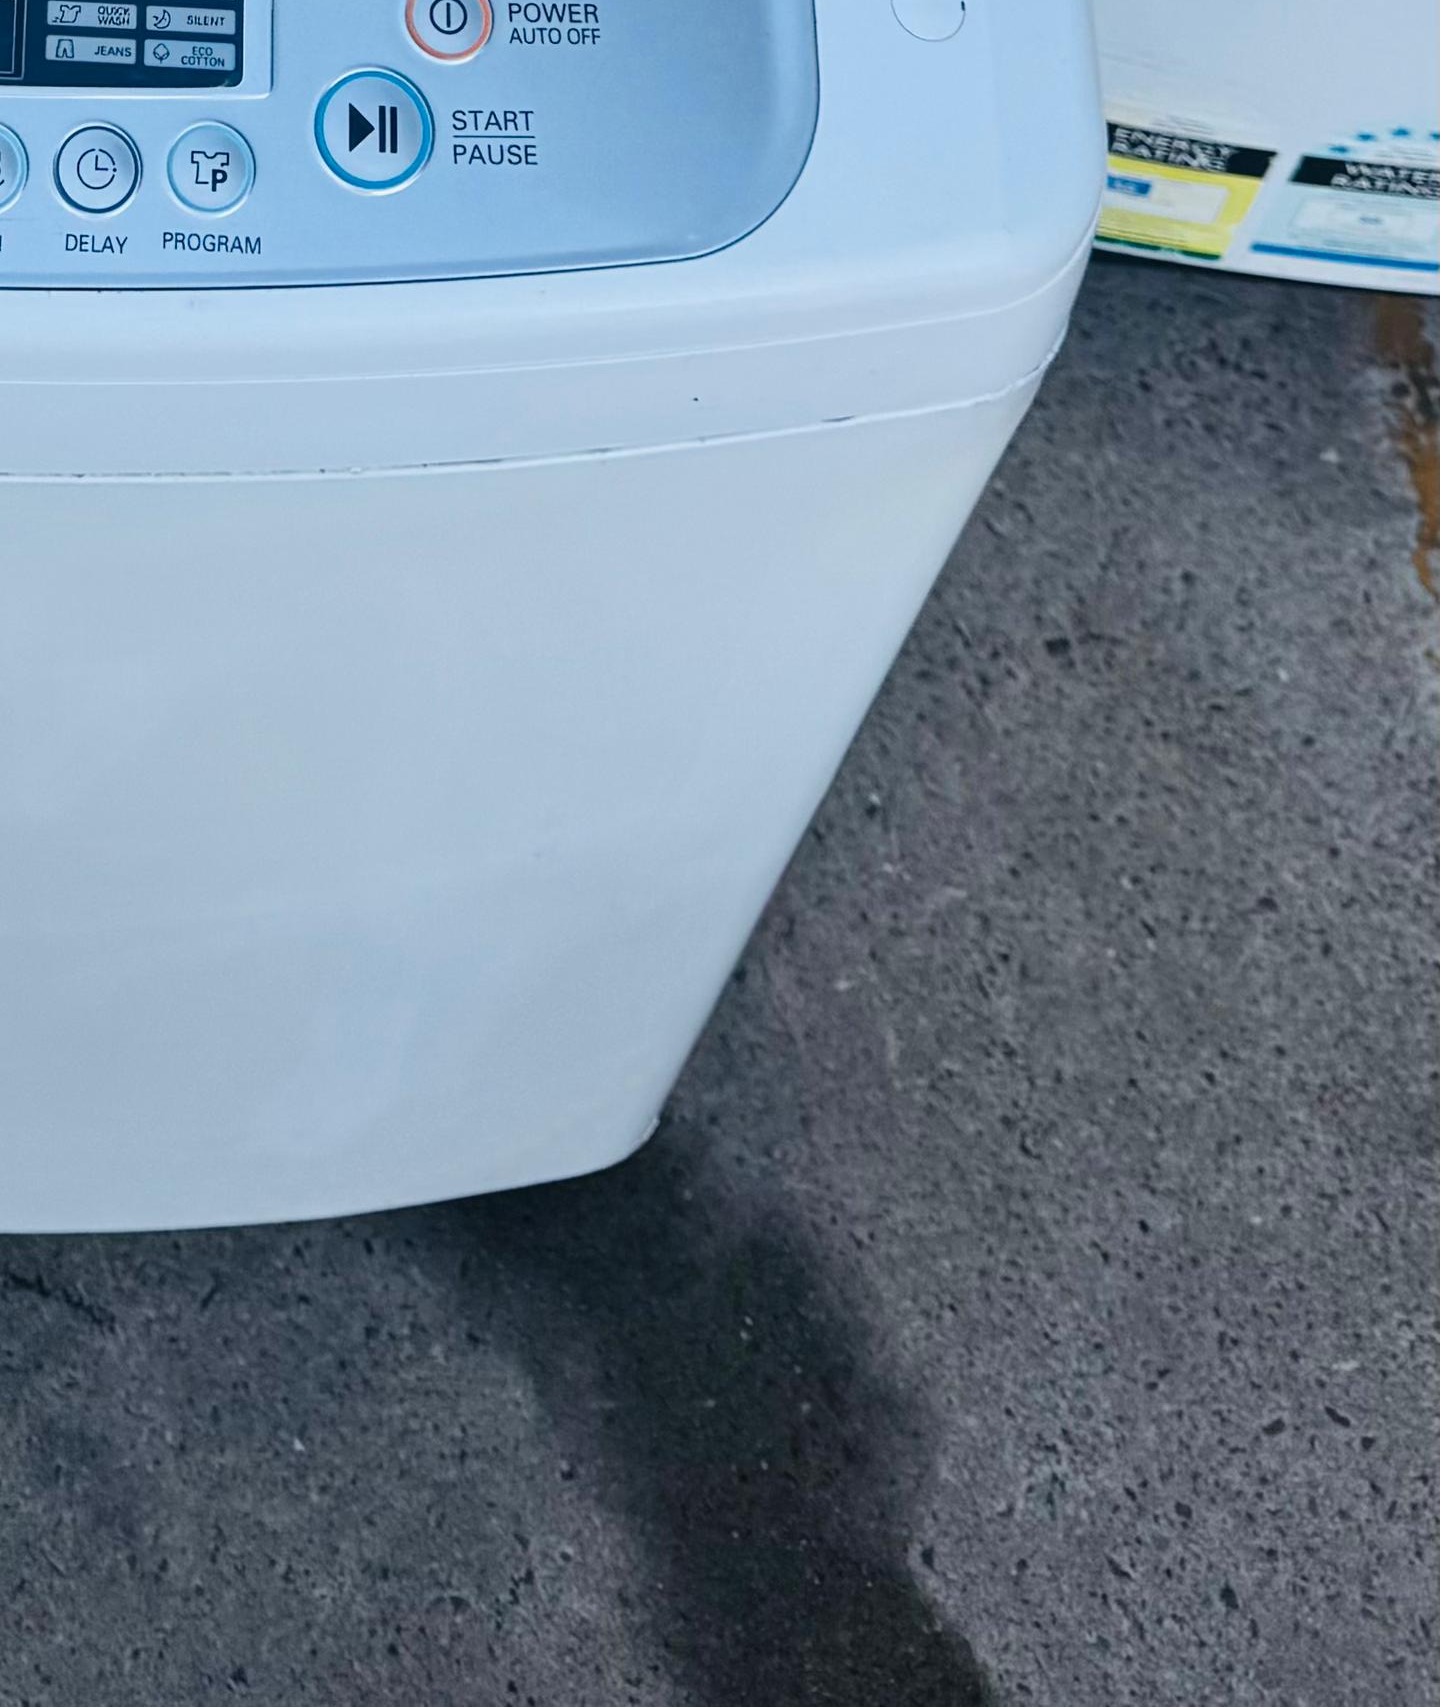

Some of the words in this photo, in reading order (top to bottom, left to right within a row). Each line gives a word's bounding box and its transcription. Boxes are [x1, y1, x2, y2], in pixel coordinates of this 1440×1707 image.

[97, 15, 131, 26] WASH
[186, 15, 226, 27] SILENT
[508, 2, 599, 23] POWER
[509, 27, 561, 45] AUTO
[567, 28, 601, 45] OFF
[94, 45, 132, 57] JEANS
[180, 56, 225, 67] COTTON
[192, 46, 214, 56] ECO
[452, 109, 534, 131] START
[1114, 127, 1239, 160] ENERGY
[453, 144, 539, 165] PAUSE
[1111, 139, 1228, 172] RATING
[65, 233, 128, 254] DELAY
[162, 232, 261, 255] PROGRAM
